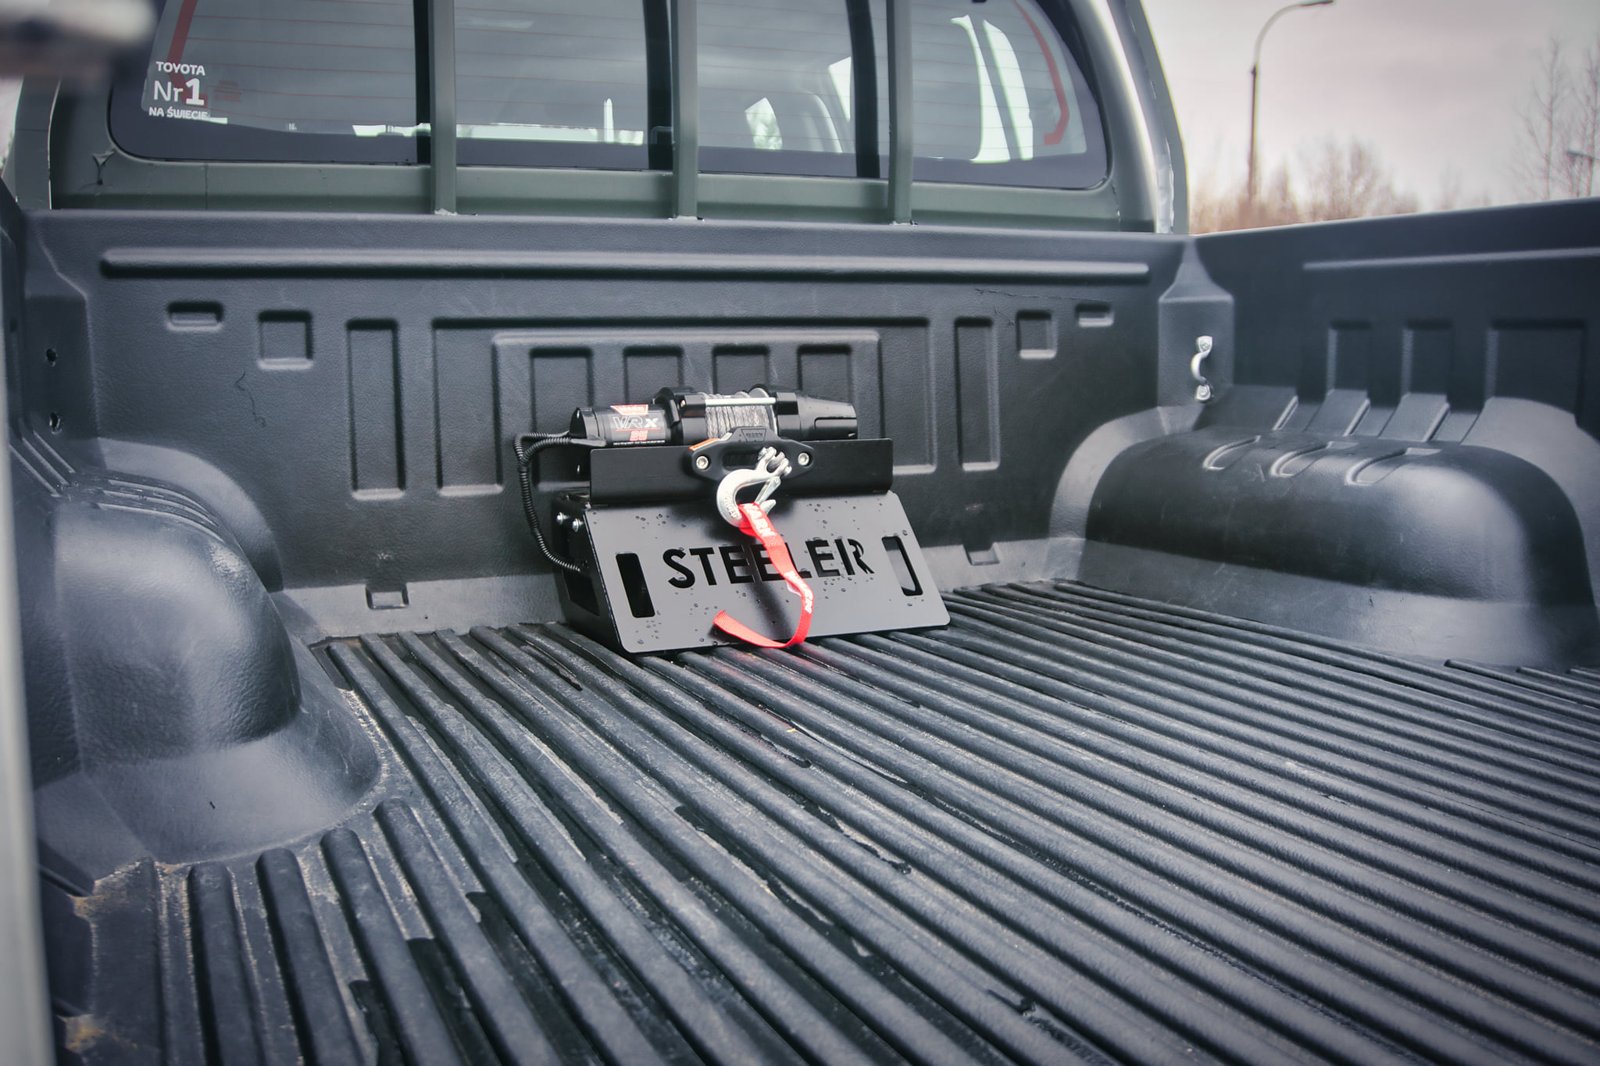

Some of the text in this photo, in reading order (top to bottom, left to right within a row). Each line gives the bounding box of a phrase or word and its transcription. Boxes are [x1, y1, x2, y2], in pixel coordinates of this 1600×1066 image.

[155, 61, 206, 76] TOYOTA
[148, 106, 209, 120] NA ŚWIECIE
